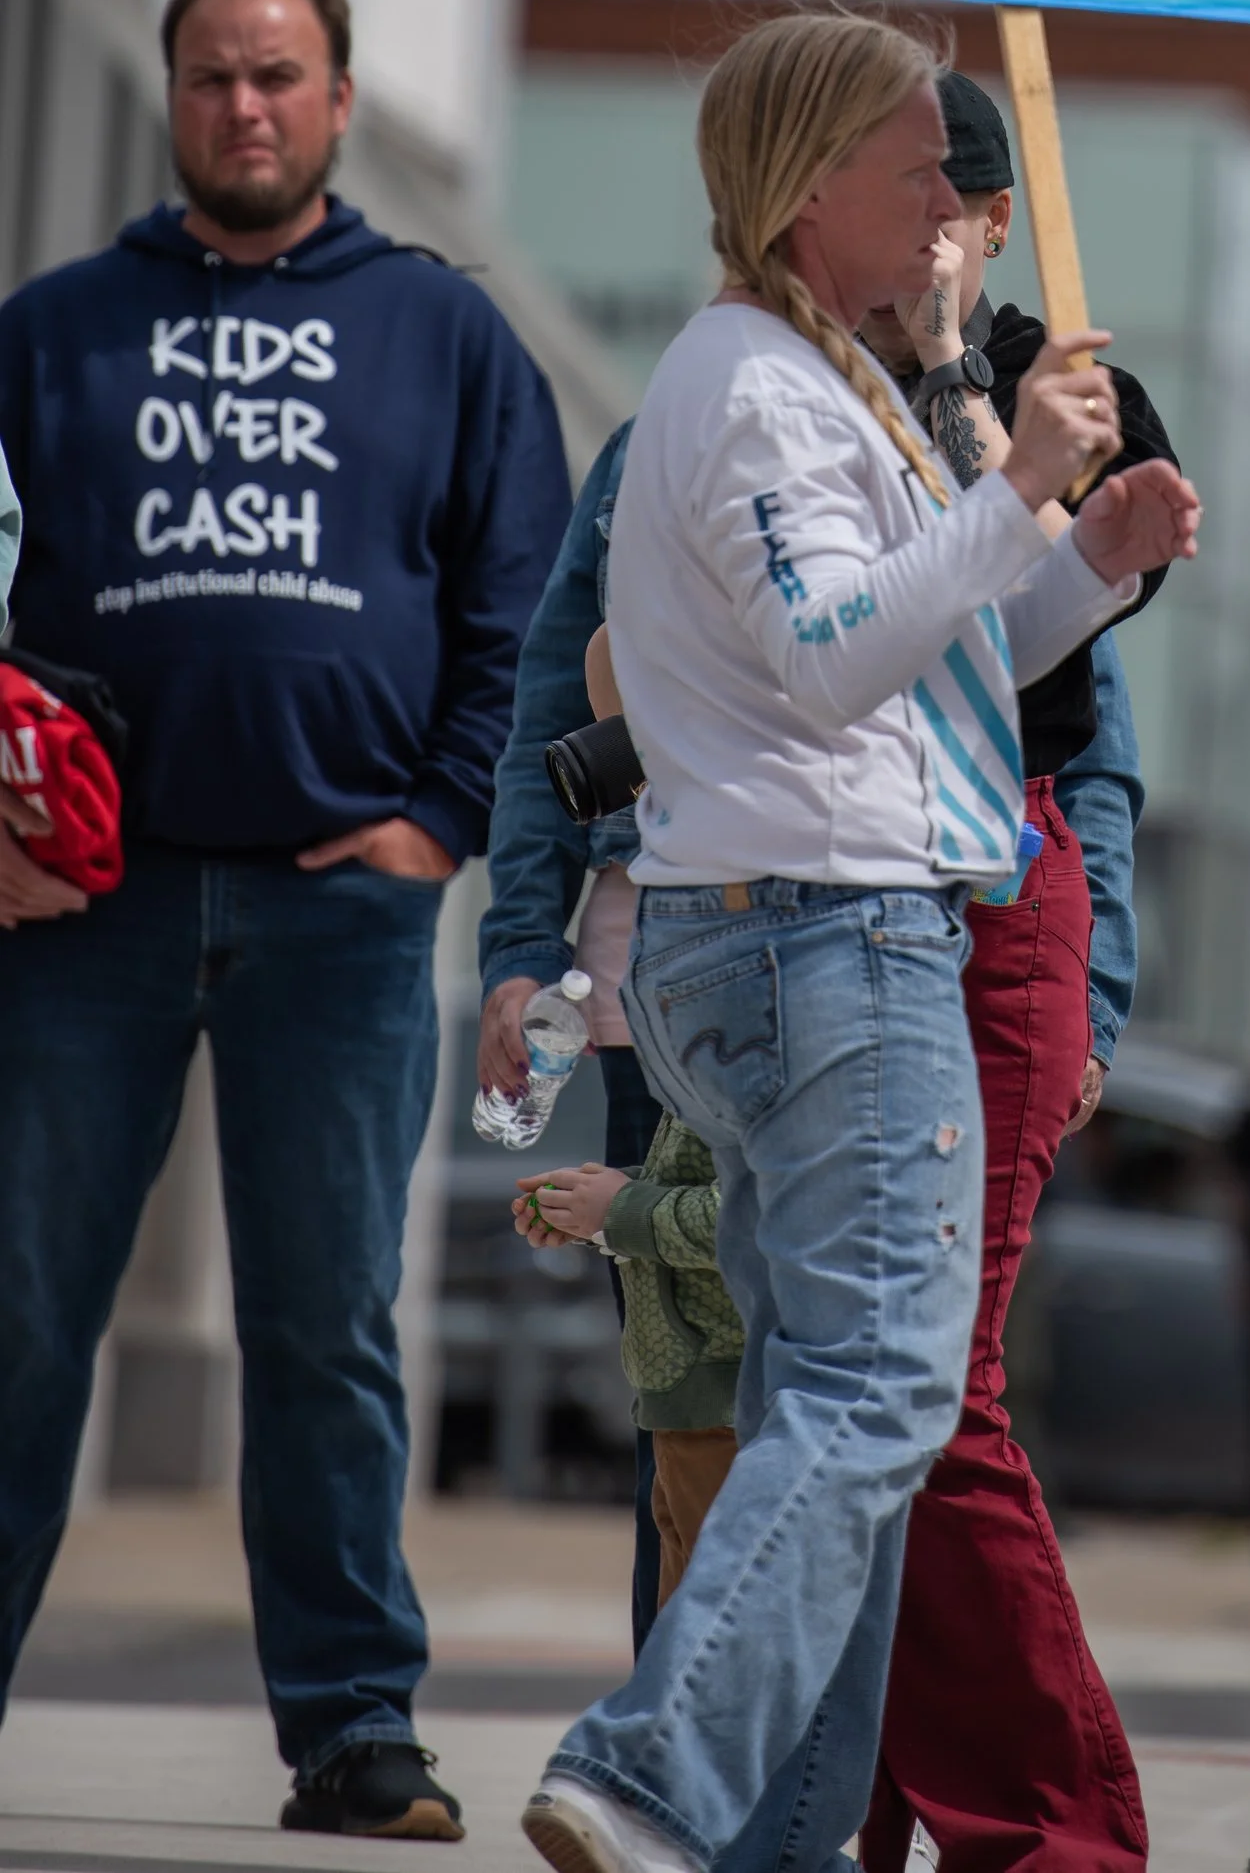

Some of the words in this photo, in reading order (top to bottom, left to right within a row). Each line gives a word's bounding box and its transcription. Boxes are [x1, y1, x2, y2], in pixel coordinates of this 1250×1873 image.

[148, 316, 338, 386] KIDS
[135, 389, 340, 472] OVER
[134, 482, 322, 568] CASH
[95, 585, 134, 615] stop
[134, 568, 256, 605] institutional
[257, 569, 307, 601] child
[307, 576, 363, 612] abuse
